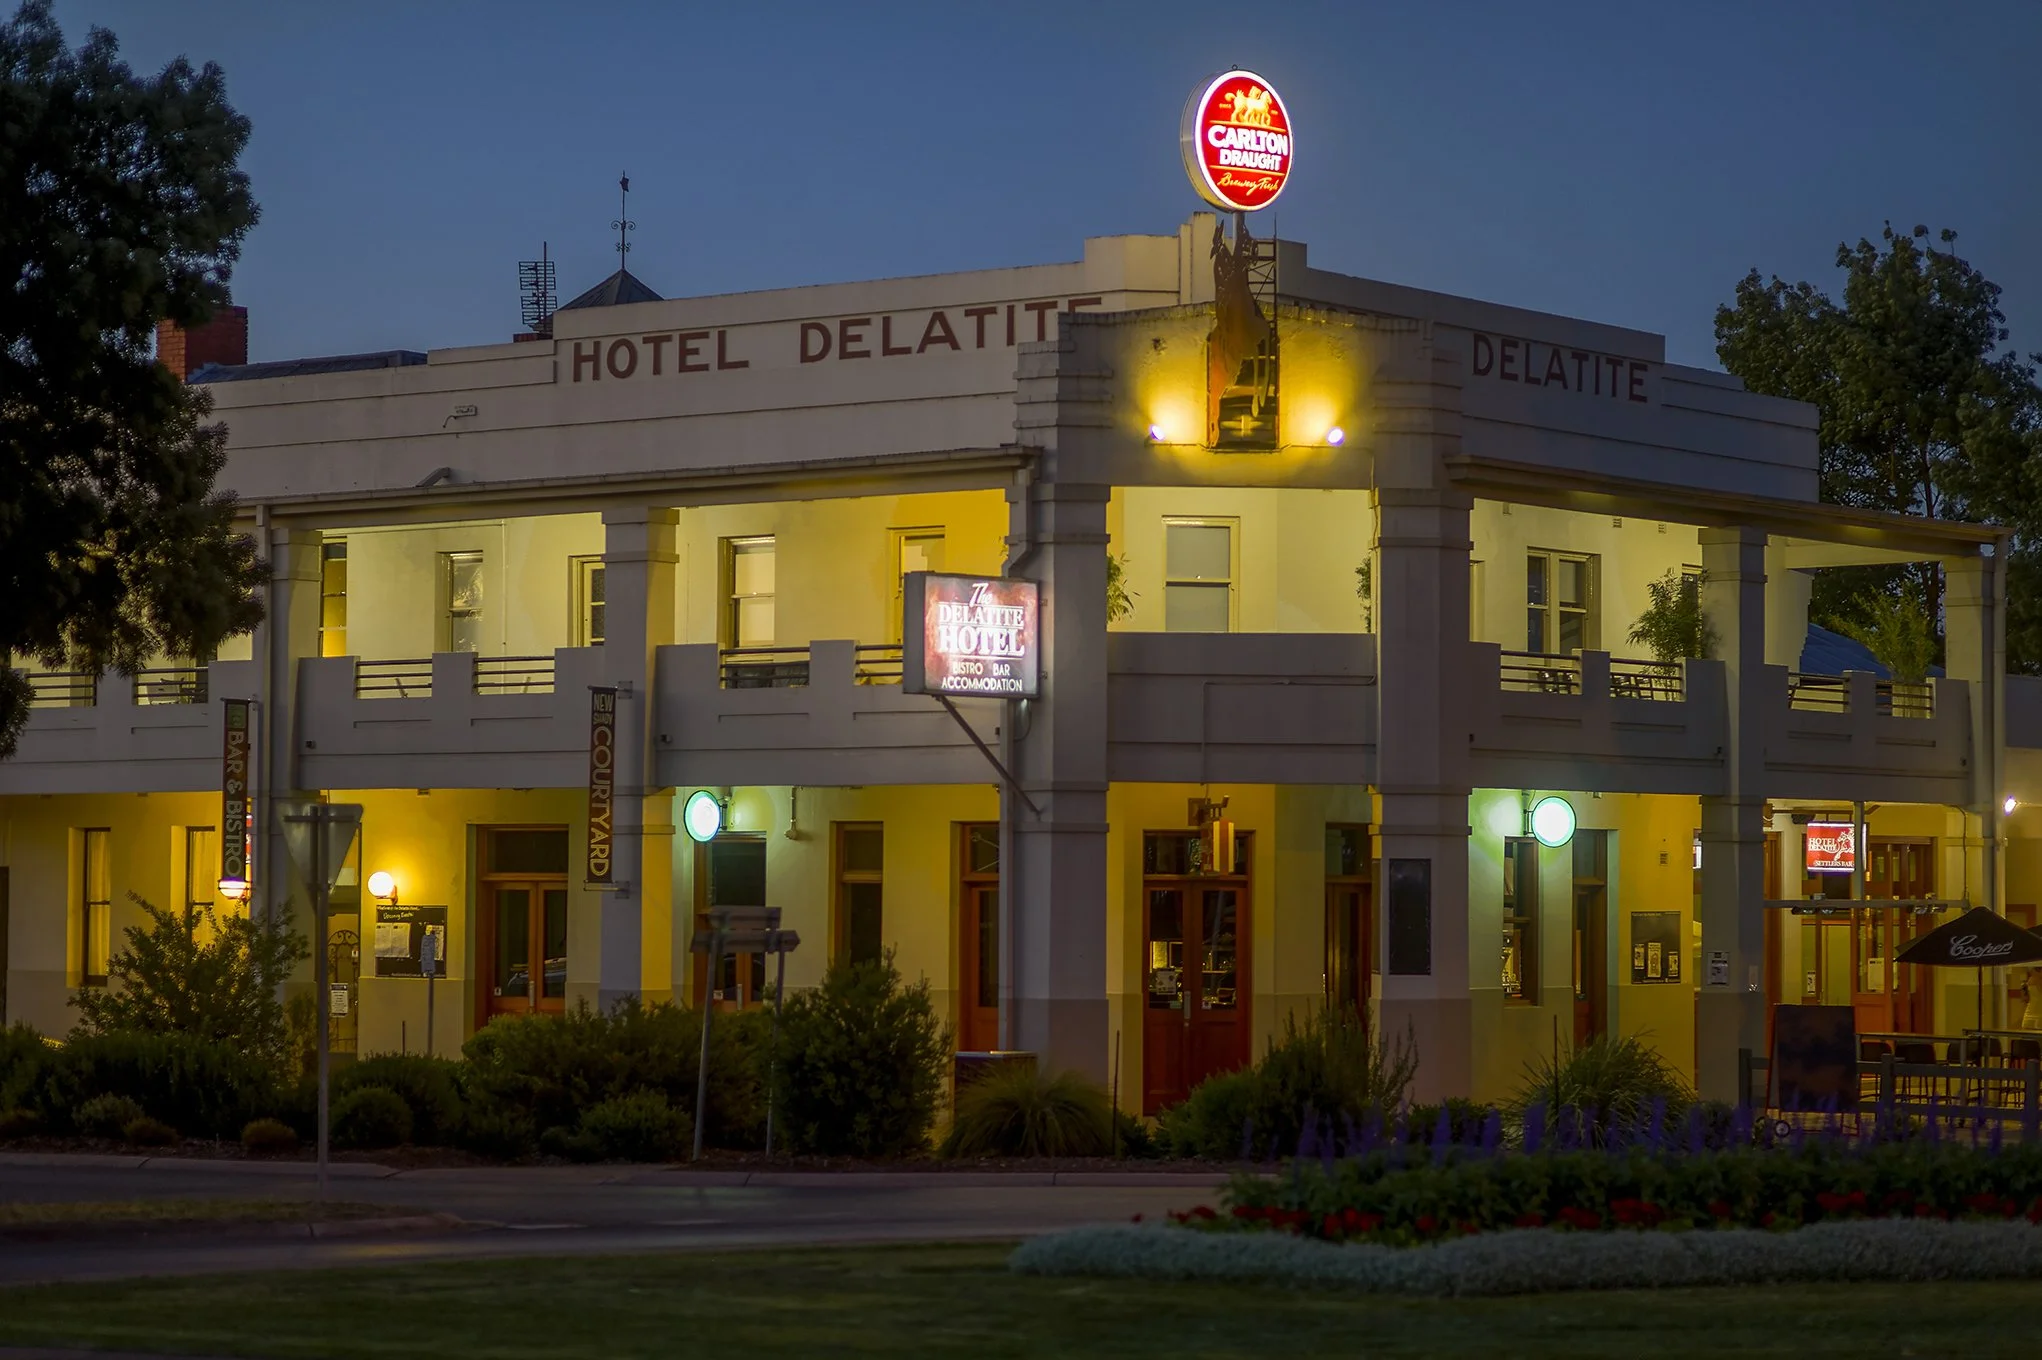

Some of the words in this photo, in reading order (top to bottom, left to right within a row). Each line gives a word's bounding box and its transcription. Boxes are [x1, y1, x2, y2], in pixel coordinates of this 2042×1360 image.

[1207, 124, 1288, 156] CARLTON
[1219, 148, 1282, 171] DRAUGHT
[1217, 172, 1258, 196] Brewery
[1257, 177, 1280, 191] Fresh
[573, 329, 750, 382] HOTEL
[1472, 333, 1649, 403] DELATITE
[968, 583, 993, 608] The
[938, 604, 1024, 628] DELATITE
[938, 625, 1025, 657] HOTEL
[952, 662, 984, 675] BISTRO
[992, 663, 1011, 676] BAR
[941, 676, 1023, 692] ACCOMMODATION
[593, 693, 614, 711] NEW
[227, 731, 244, 774] BAR
[226, 779, 243, 795] &
[590, 725, 613, 876] COURTYARD
[225, 800, 243, 876] BISTRO
[1808, 837, 1836, 845] HOTEL
[1950, 934, 2014, 958] Coopers
